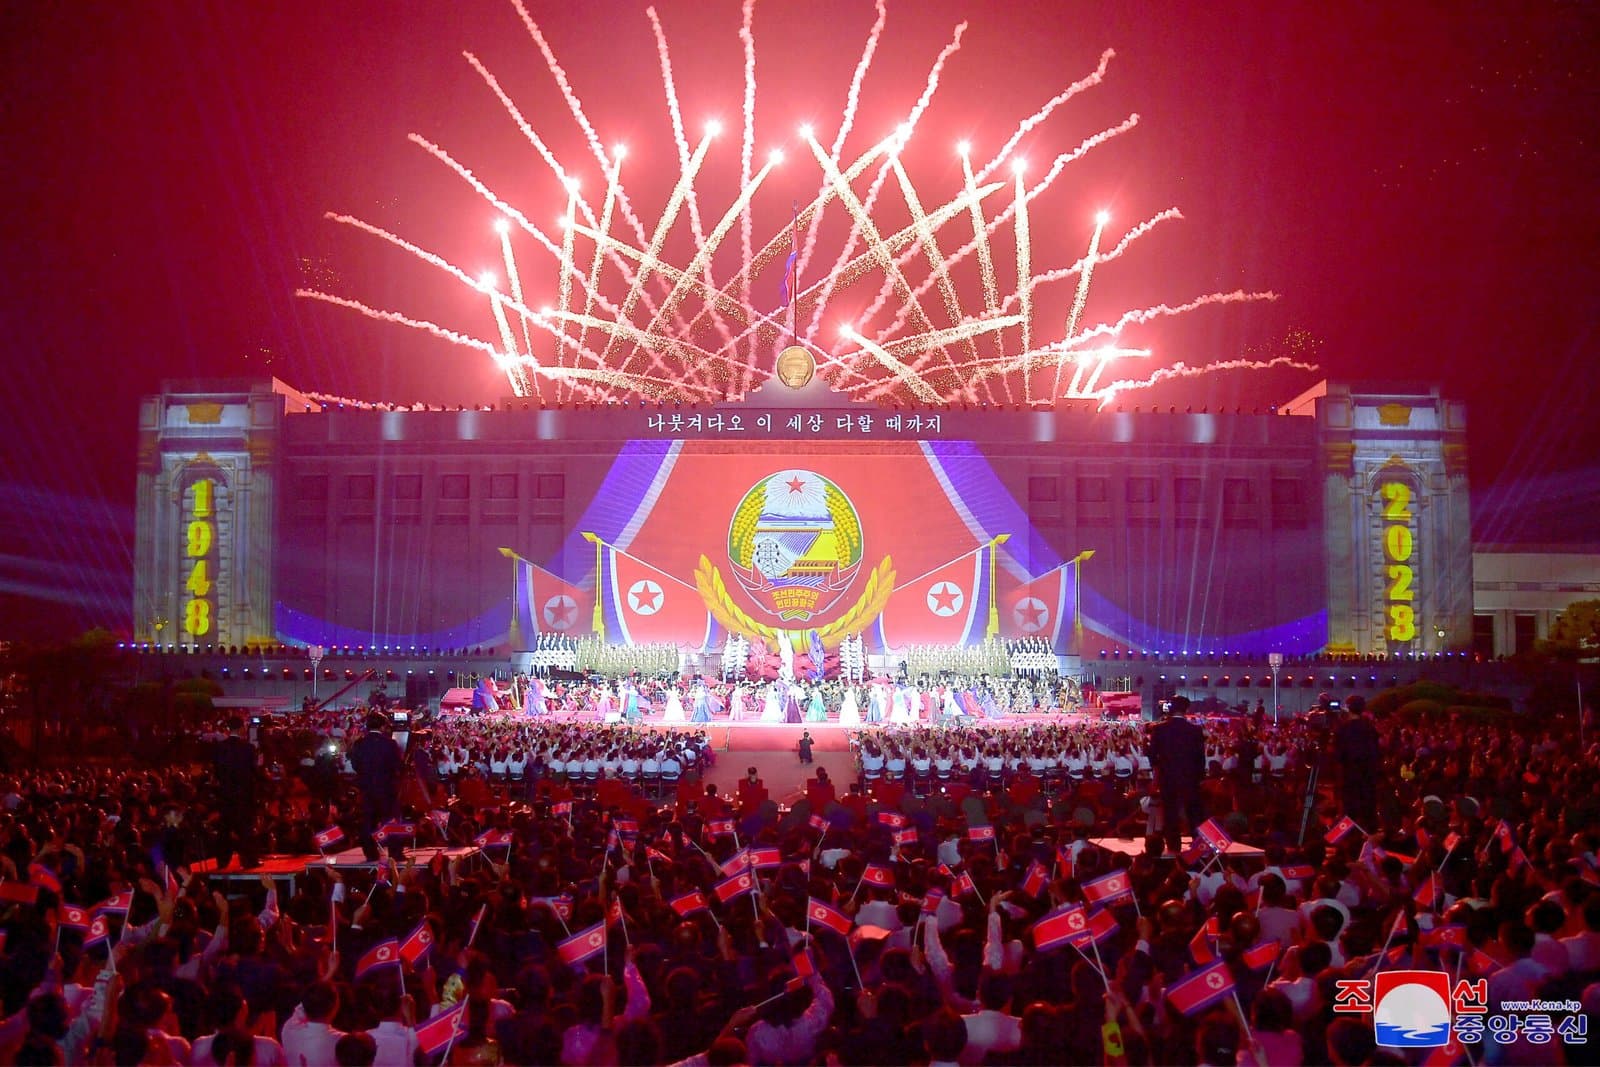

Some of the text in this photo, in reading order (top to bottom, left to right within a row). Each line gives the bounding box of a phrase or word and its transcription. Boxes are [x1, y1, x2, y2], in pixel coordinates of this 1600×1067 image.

[648, 413, 942, 433] 나붓겨다오 이 세상 다할 때까지
[186, 479, 213, 636] 1948
[1382, 482, 1416, 642] 2023
